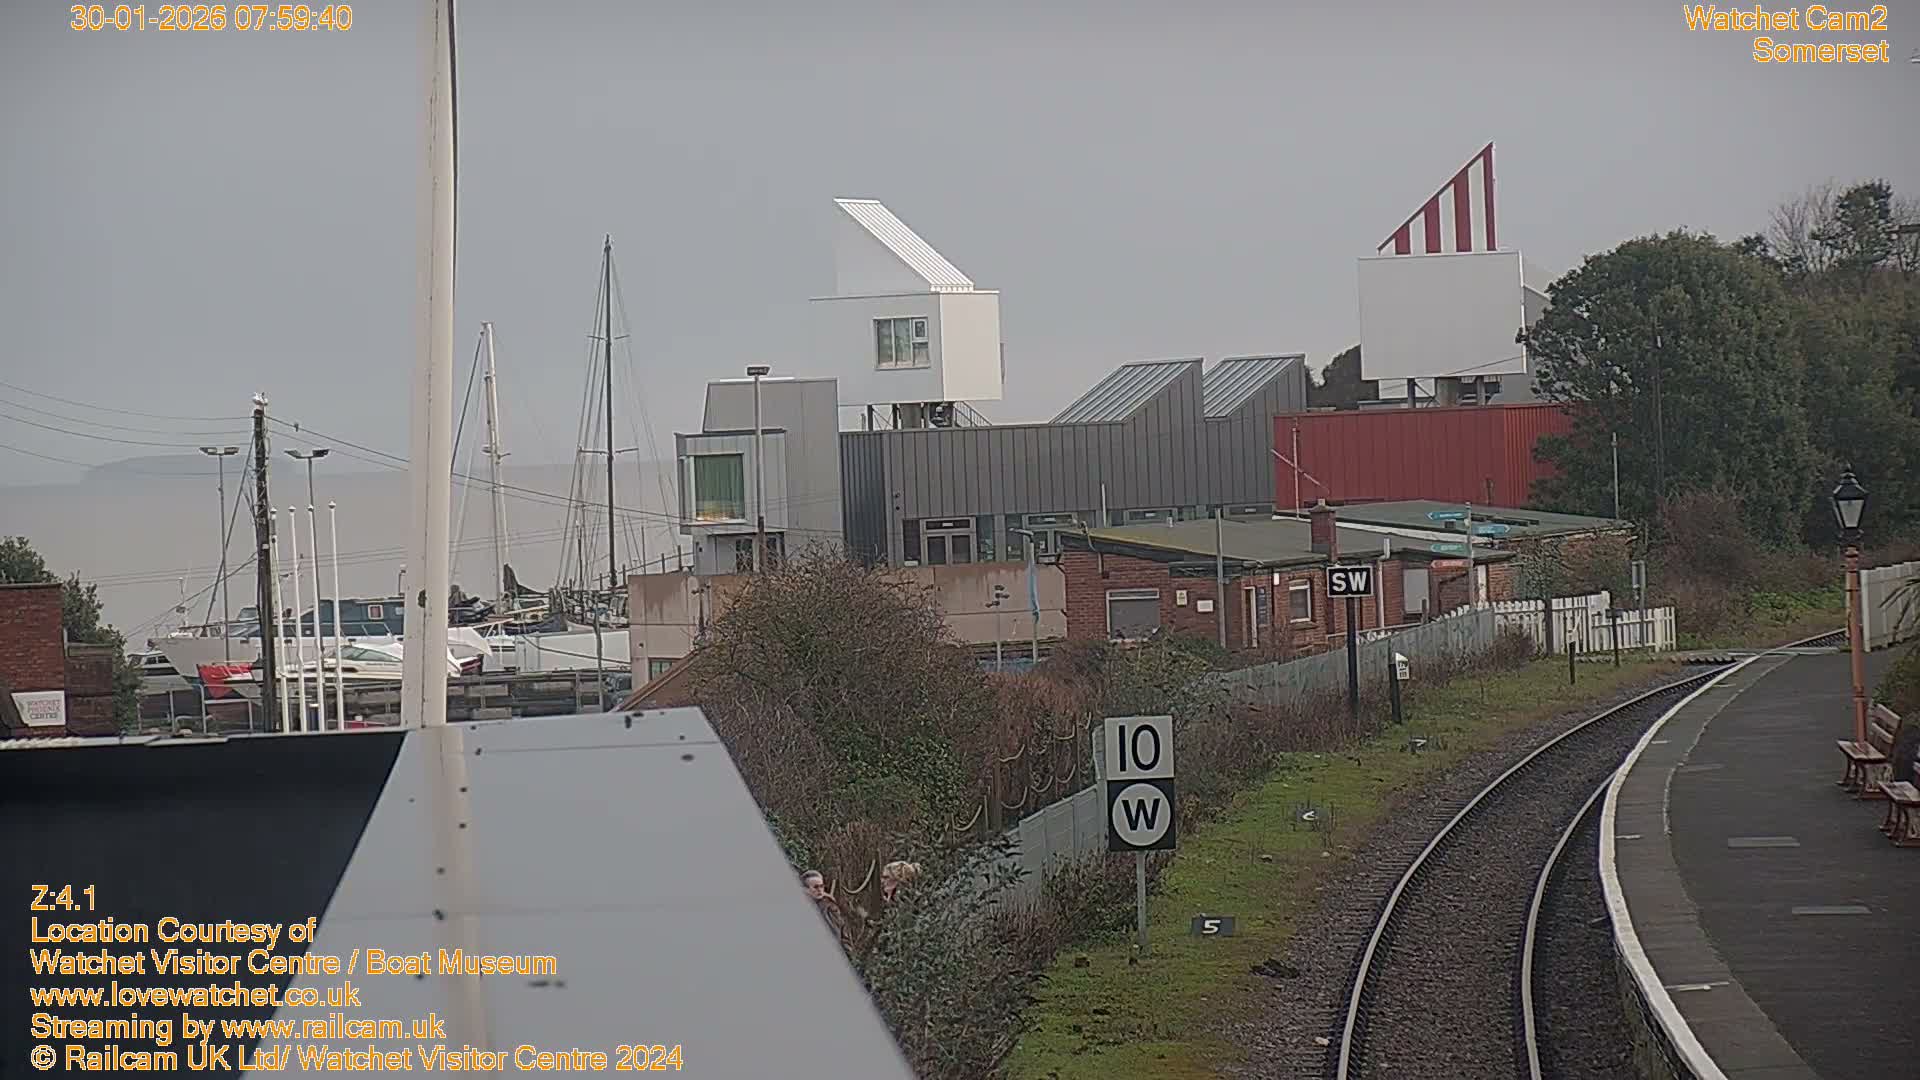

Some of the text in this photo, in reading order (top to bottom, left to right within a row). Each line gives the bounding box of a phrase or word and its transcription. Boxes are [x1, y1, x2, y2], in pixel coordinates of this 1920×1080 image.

[1332, 571, 1367, 592] SW
[1118, 724, 1160, 772] 10
[1121, 798, 1161, 831] W
[1202, 919, 1221, 934] 5
